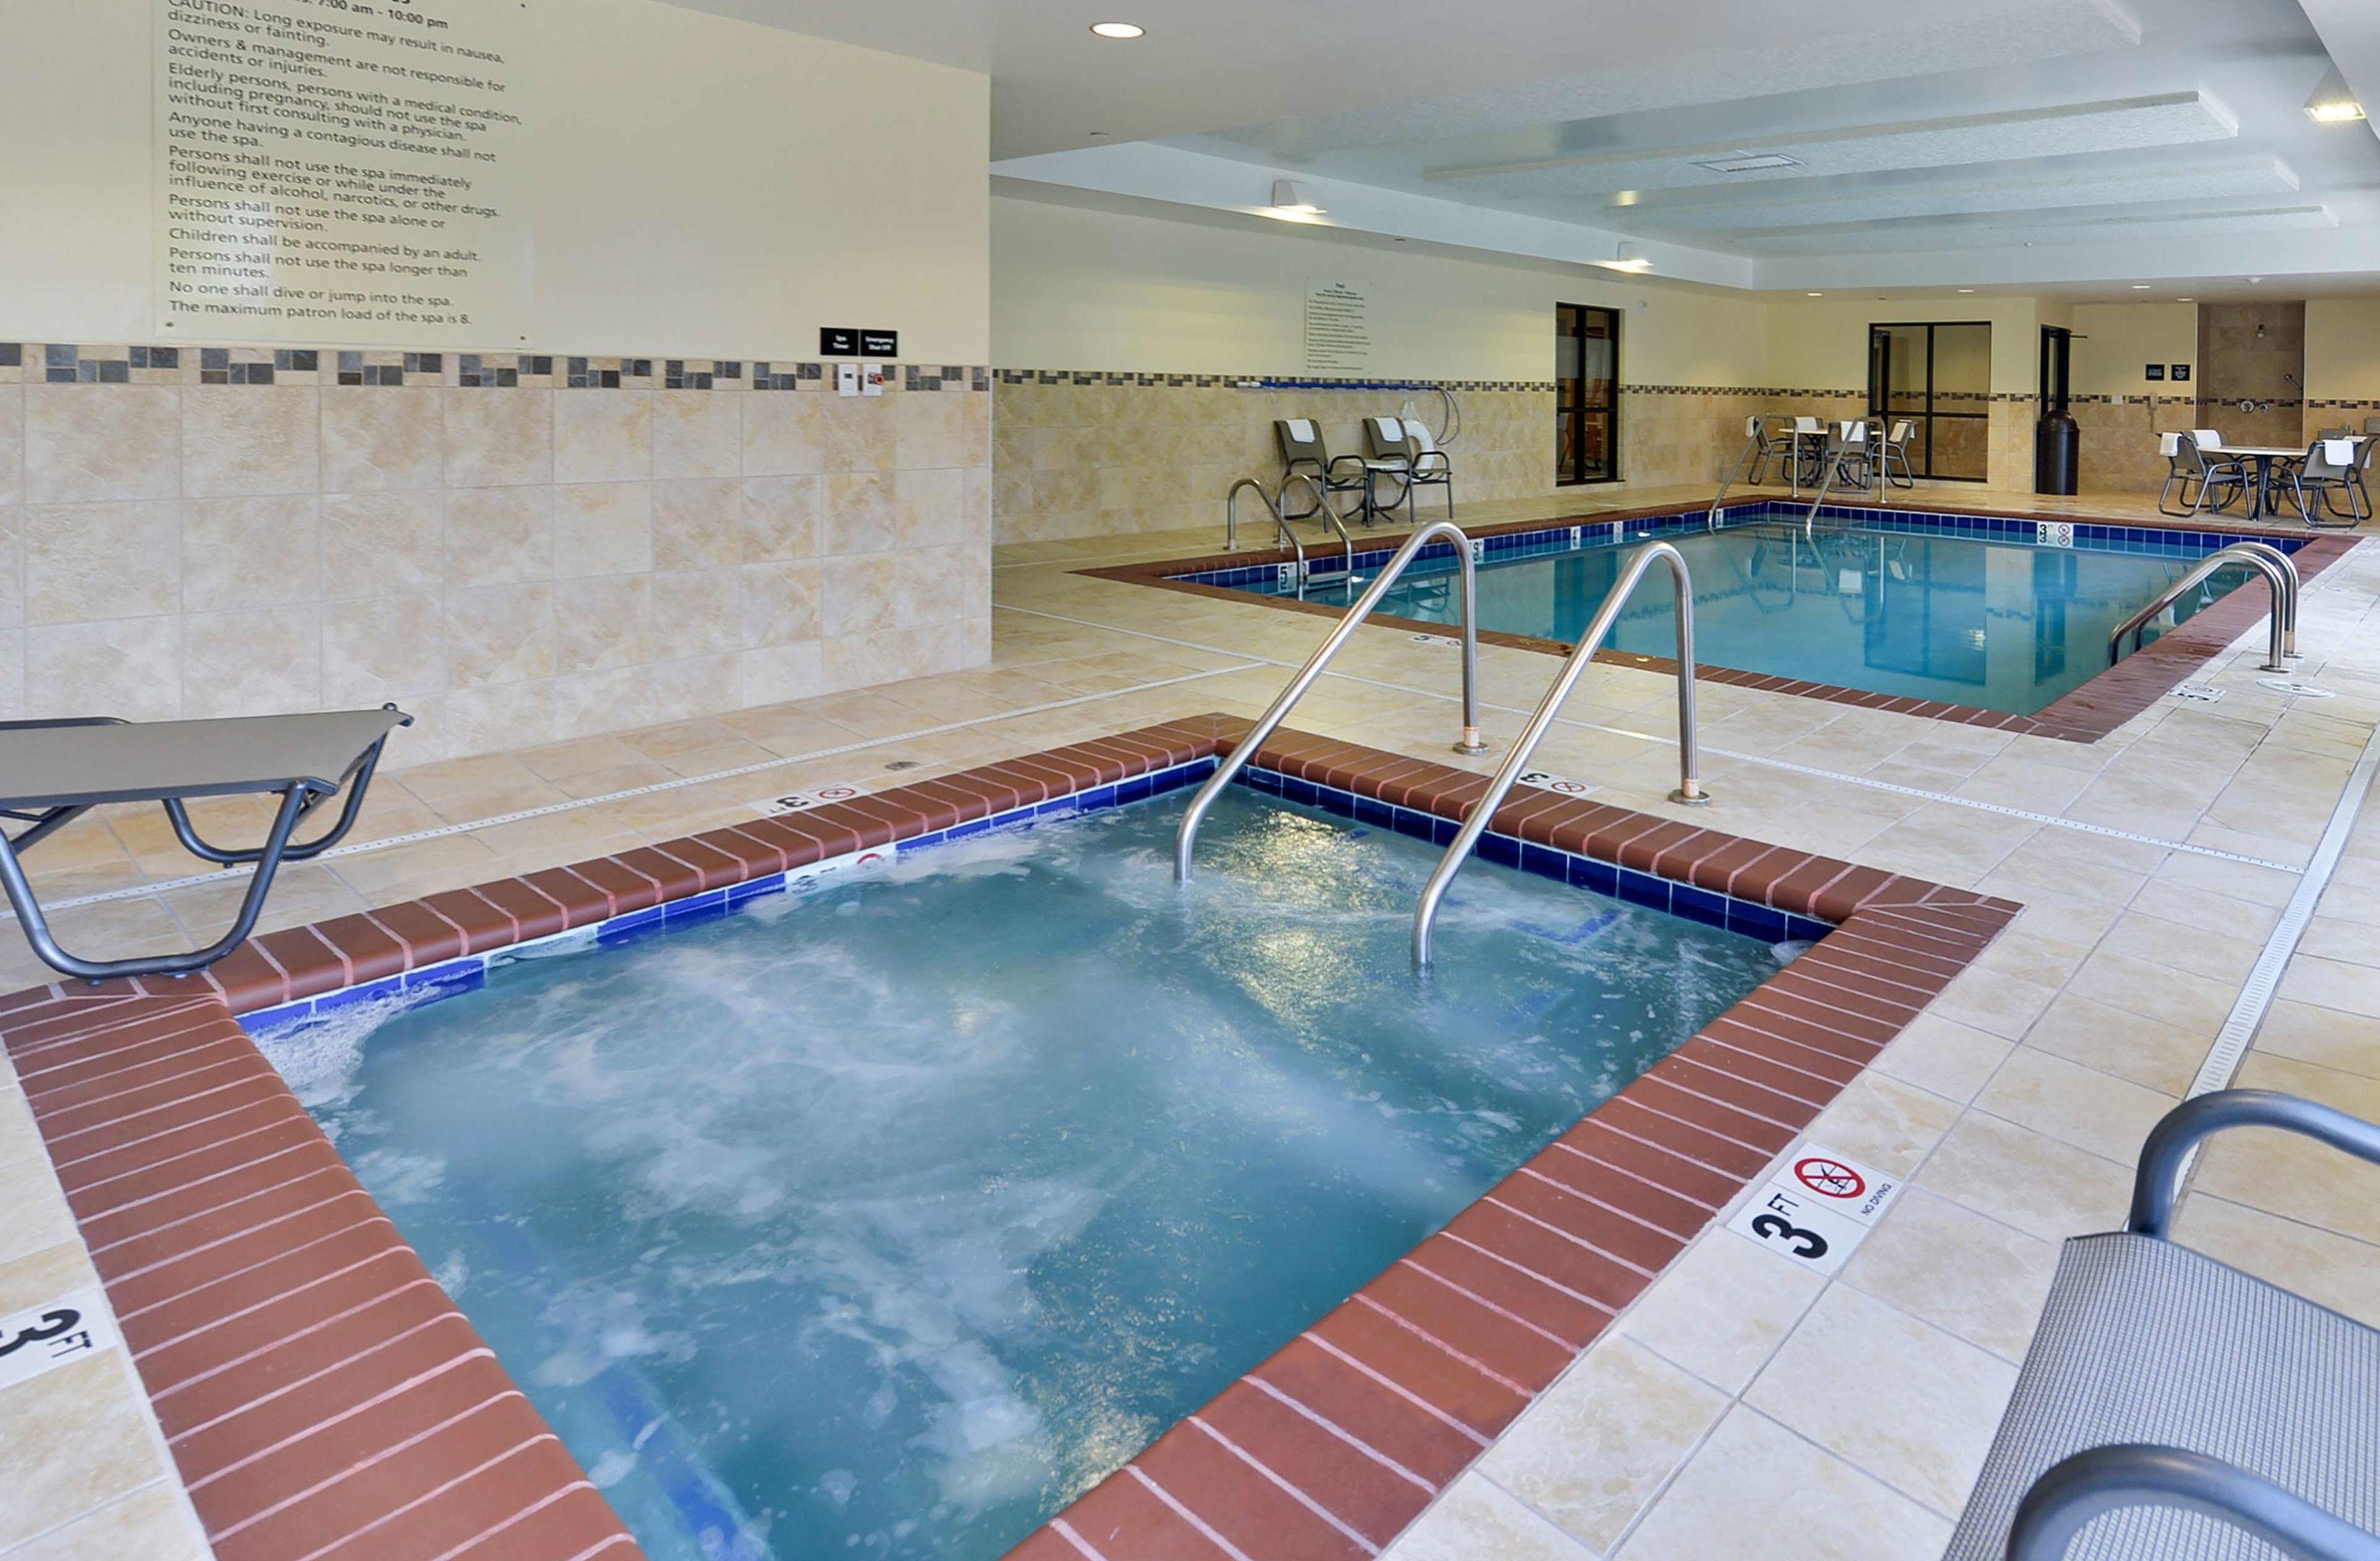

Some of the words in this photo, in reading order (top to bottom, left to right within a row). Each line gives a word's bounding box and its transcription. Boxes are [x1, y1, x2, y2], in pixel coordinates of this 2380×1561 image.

[168, 8, 240, 31] dizziness
[244, 22, 262, 34] or
[267, 23, 330, 48] fainting.
[254, 9, 292, 29] Long
[296, 19, 361, 37] exposure
[366, 32, 396, 46] may
[400, 38, 437, 51] result
[441, 43, 454, 53] in
[351, 4, 374, 15] am
[388, 7, 424, 25] 10:00
[427, 19, 448, 30] pm
[168, 28, 231, 48] Owners
[236, 39, 248, 51] &
[252, 44, 352, 68] management
[356, 61, 379, 72] are
[382, 65, 407, 77] not
[410, 69, 484, 89] responsible
[487, 79, 505, 92] for
[168, 45, 244, 64] accidents
[247, 57, 264, 67] or
[268, 57, 327, 77] injuries.
[169, 62, 225, 85] Elderly
[228, 74, 292, 93] persons,
[297, 83, 353, 100] persons
[356, 91, 389, 104] with
[392, 98, 401, 106] a
[405, 100, 456, 114] medical
[168, 93, 235, 111] without
[239, 99, 270, 116] first
[272, 107, 351, 129] consulting
[353, 116, 386, 130] with
[390, 124, 398, 132] a
[169, 77, 244, 100] including
[334, 99, 383, 116] should
[386, 108, 411, 121] not
[413, 114, 437, 124] use
[440, 113, 463, 128] the
[465, 119, 486, 134] spa
[168, 111, 232, 129] Anyone
[236, 119, 289, 139] having
[293, 129, 302, 138] a
[306, 129, 386, 148] contagious
[389, 139, 438, 155] disease
[441, 146, 471, 158] shall
[474, 152, 496, 162] not
[169, 128, 197, 139] use
[200, 129, 229, 143] the
[168, 159, 248, 183] following
[252, 170, 312, 185] exercise
[316, 176, 332, 187] or
[335, 176, 376, 192] while
[379, 181, 420, 196] under
[423, 185, 446, 199] the
[169, 145, 231, 163] Persons
[234, 151, 270, 166] shall
[275, 159, 302, 170] not
[305, 163, 331, 173] use
[334, 163, 359, 176] the
[361, 169, 386, 181] spa
[389, 169, 471, 193] immediately
[169, 173, 246, 192] influence
[249, 181, 267, 194] of
[270, 183, 329, 202] alcohol,
[403, 198, 418, 210] or
[421, 199, 458, 212] other
[168, 208, 235, 225] without
[239, 215, 327, 233] supervision.
[169, 194, 231, 210] Persons
[234, 198, 270, 212] shall
[275, 204, 301, 216] not
[305, 208, 330, 219] use
[333, 208, 359, 221] the
[361, 212, 386, 226] spa
[389, 212, 428, 227] alone
[431, 220, 446, 228] or
[169, 228, 239, 244] Children
[241, 232, 278, 246] shall
[282, 236, 301, 248] be
[305, 240, 400, 257] accompanied
[403, 245, 420, 261] by
[423, 249, 440, 258] an
[168, 261, 197, 274] ten
[201, 263, 269, 278] minutes.
[169, 247, 231, 262] Persons
[235, 251, 270, 264] shall
[275, 255, 301, 267] not
[305, 259, 330, 268] use
[334, 258, 358, 270] the
[361, 262, 386, 275] spa
[390, 262, 434, 278] longer
[437, 265, 468, 277] than
[169, 281, 194, 293] No
[197, 285, 229, 295] one
[233, 284, 268, 297] shall
[272, 286, 305, 298] dive
[308, 291, 325, 299] or
[327, 290, 366, 306] jump
[370, 292, 398, 304] into
[401, 293, 424, 305] the
[169, 300, 200, 312] The
[205, 303, 282, 316] maximum
[286, 308, 337, 320] patron
[340, 308, 372, 319] load
[376, 309, 392, 320] of
[395, 311, 418, 322] the
[421, 314, 444, 327] spa
[447, 313, 457, 323] is
[776, 796, 809, 808] 3
[1766, 1193, 1800, 1217] FT
[1860, 1205, 1875, 1216] NO
[1869, 1183, 1892, 1205] DIVING
[1752, 1214, 1829, 1259] 3
[0, 1309, 81, 1357] 3
[47, 1330, 93, 1358] FT
